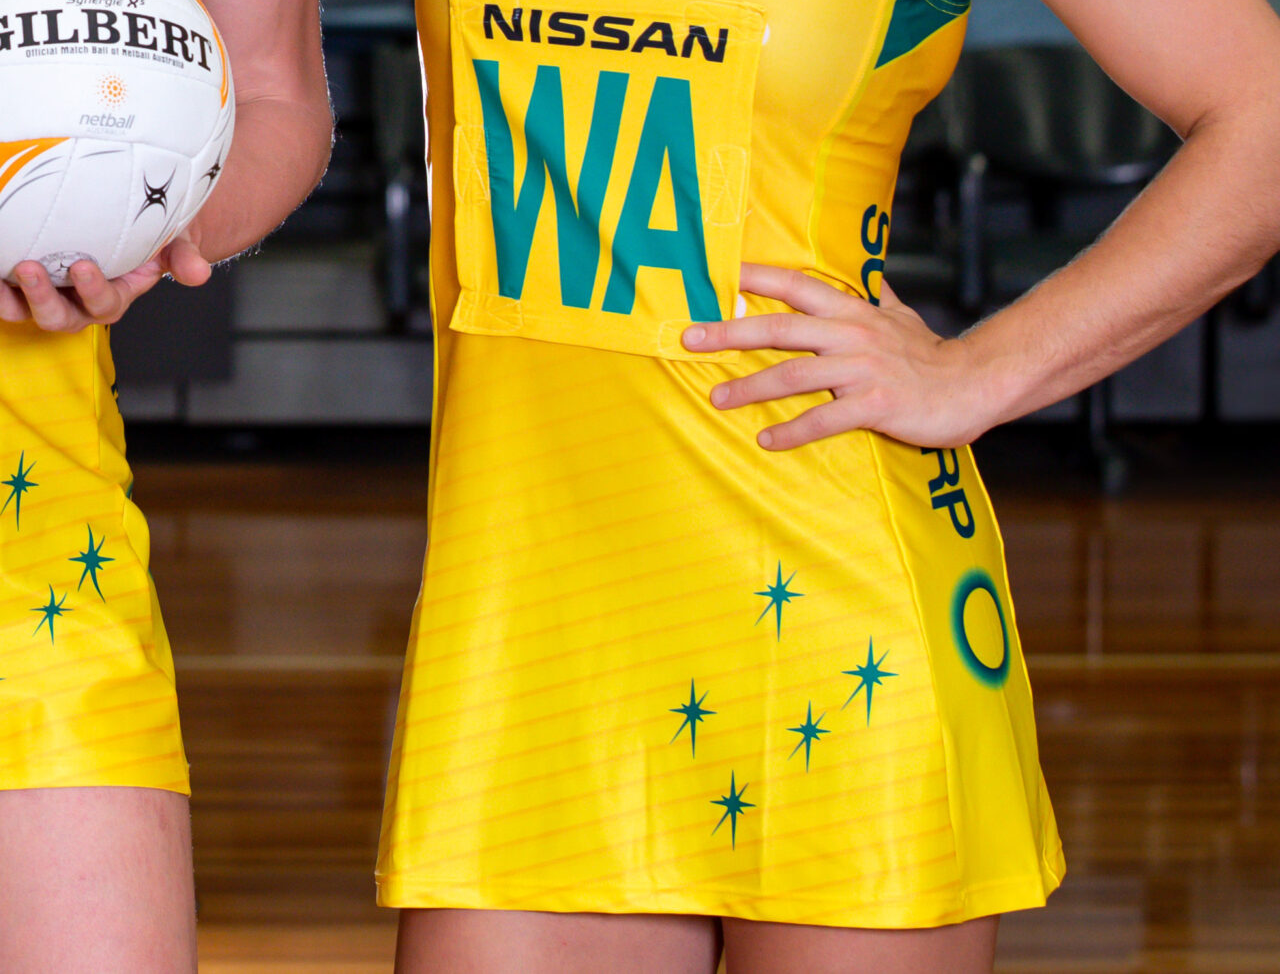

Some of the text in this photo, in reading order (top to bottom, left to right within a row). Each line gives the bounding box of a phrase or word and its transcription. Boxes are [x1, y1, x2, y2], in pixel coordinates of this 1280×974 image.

[483, 3, 729, 63] NISSAN
[79, 113, 135, 129] netball
[472, 58, 724, 323] WA
